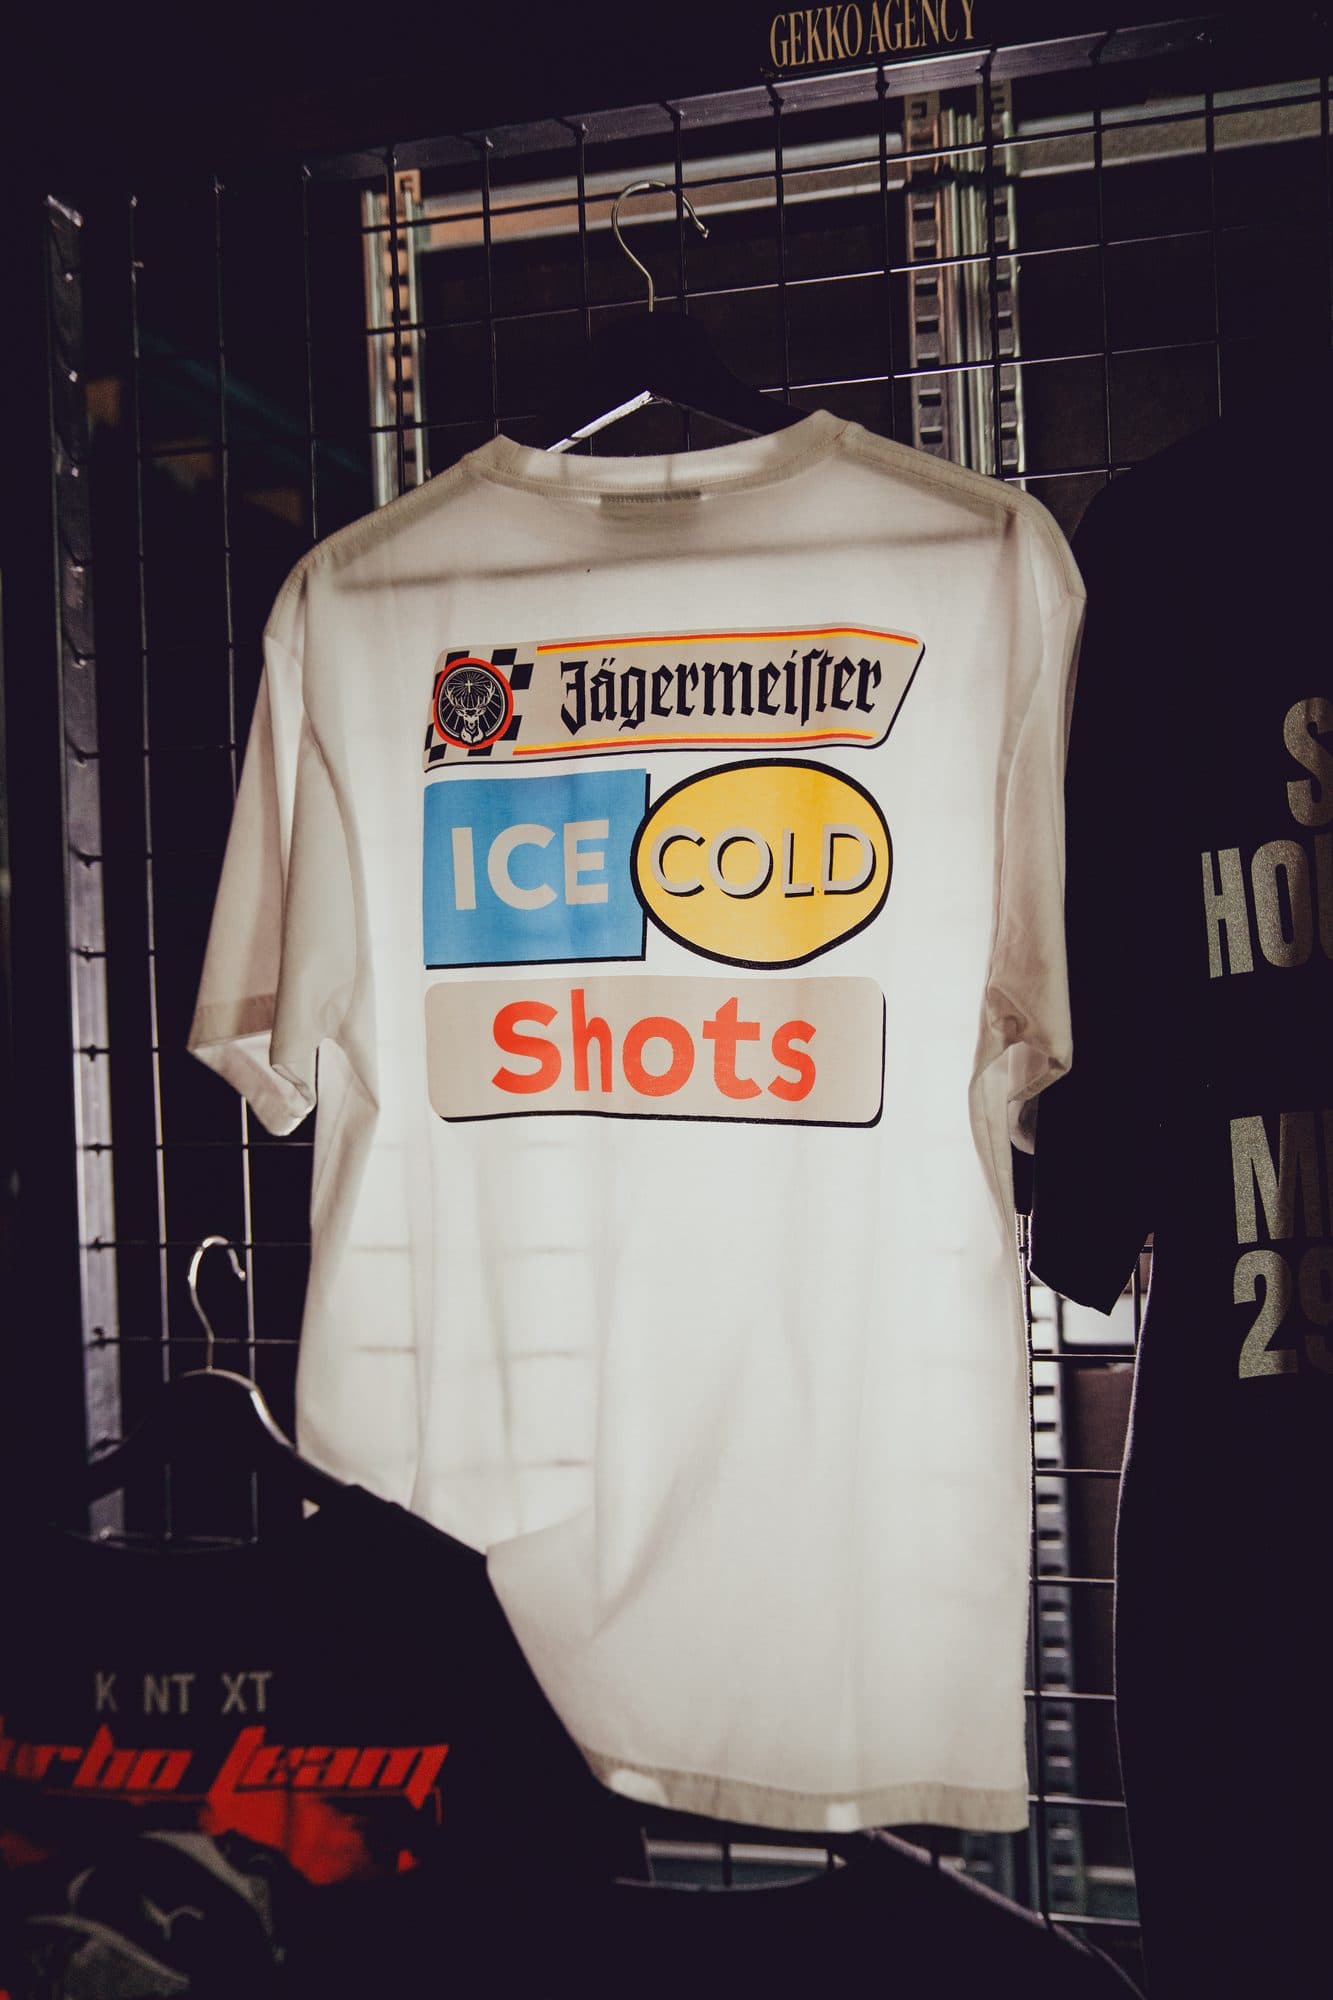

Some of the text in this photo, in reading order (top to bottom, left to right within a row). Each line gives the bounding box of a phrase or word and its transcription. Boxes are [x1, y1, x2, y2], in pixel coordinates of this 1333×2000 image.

[770, 0, 975, 68] GEKKO AGENCY
[452, 818, 877, 911] ICE COLD
[492, 988, 817, 1102] Shots
